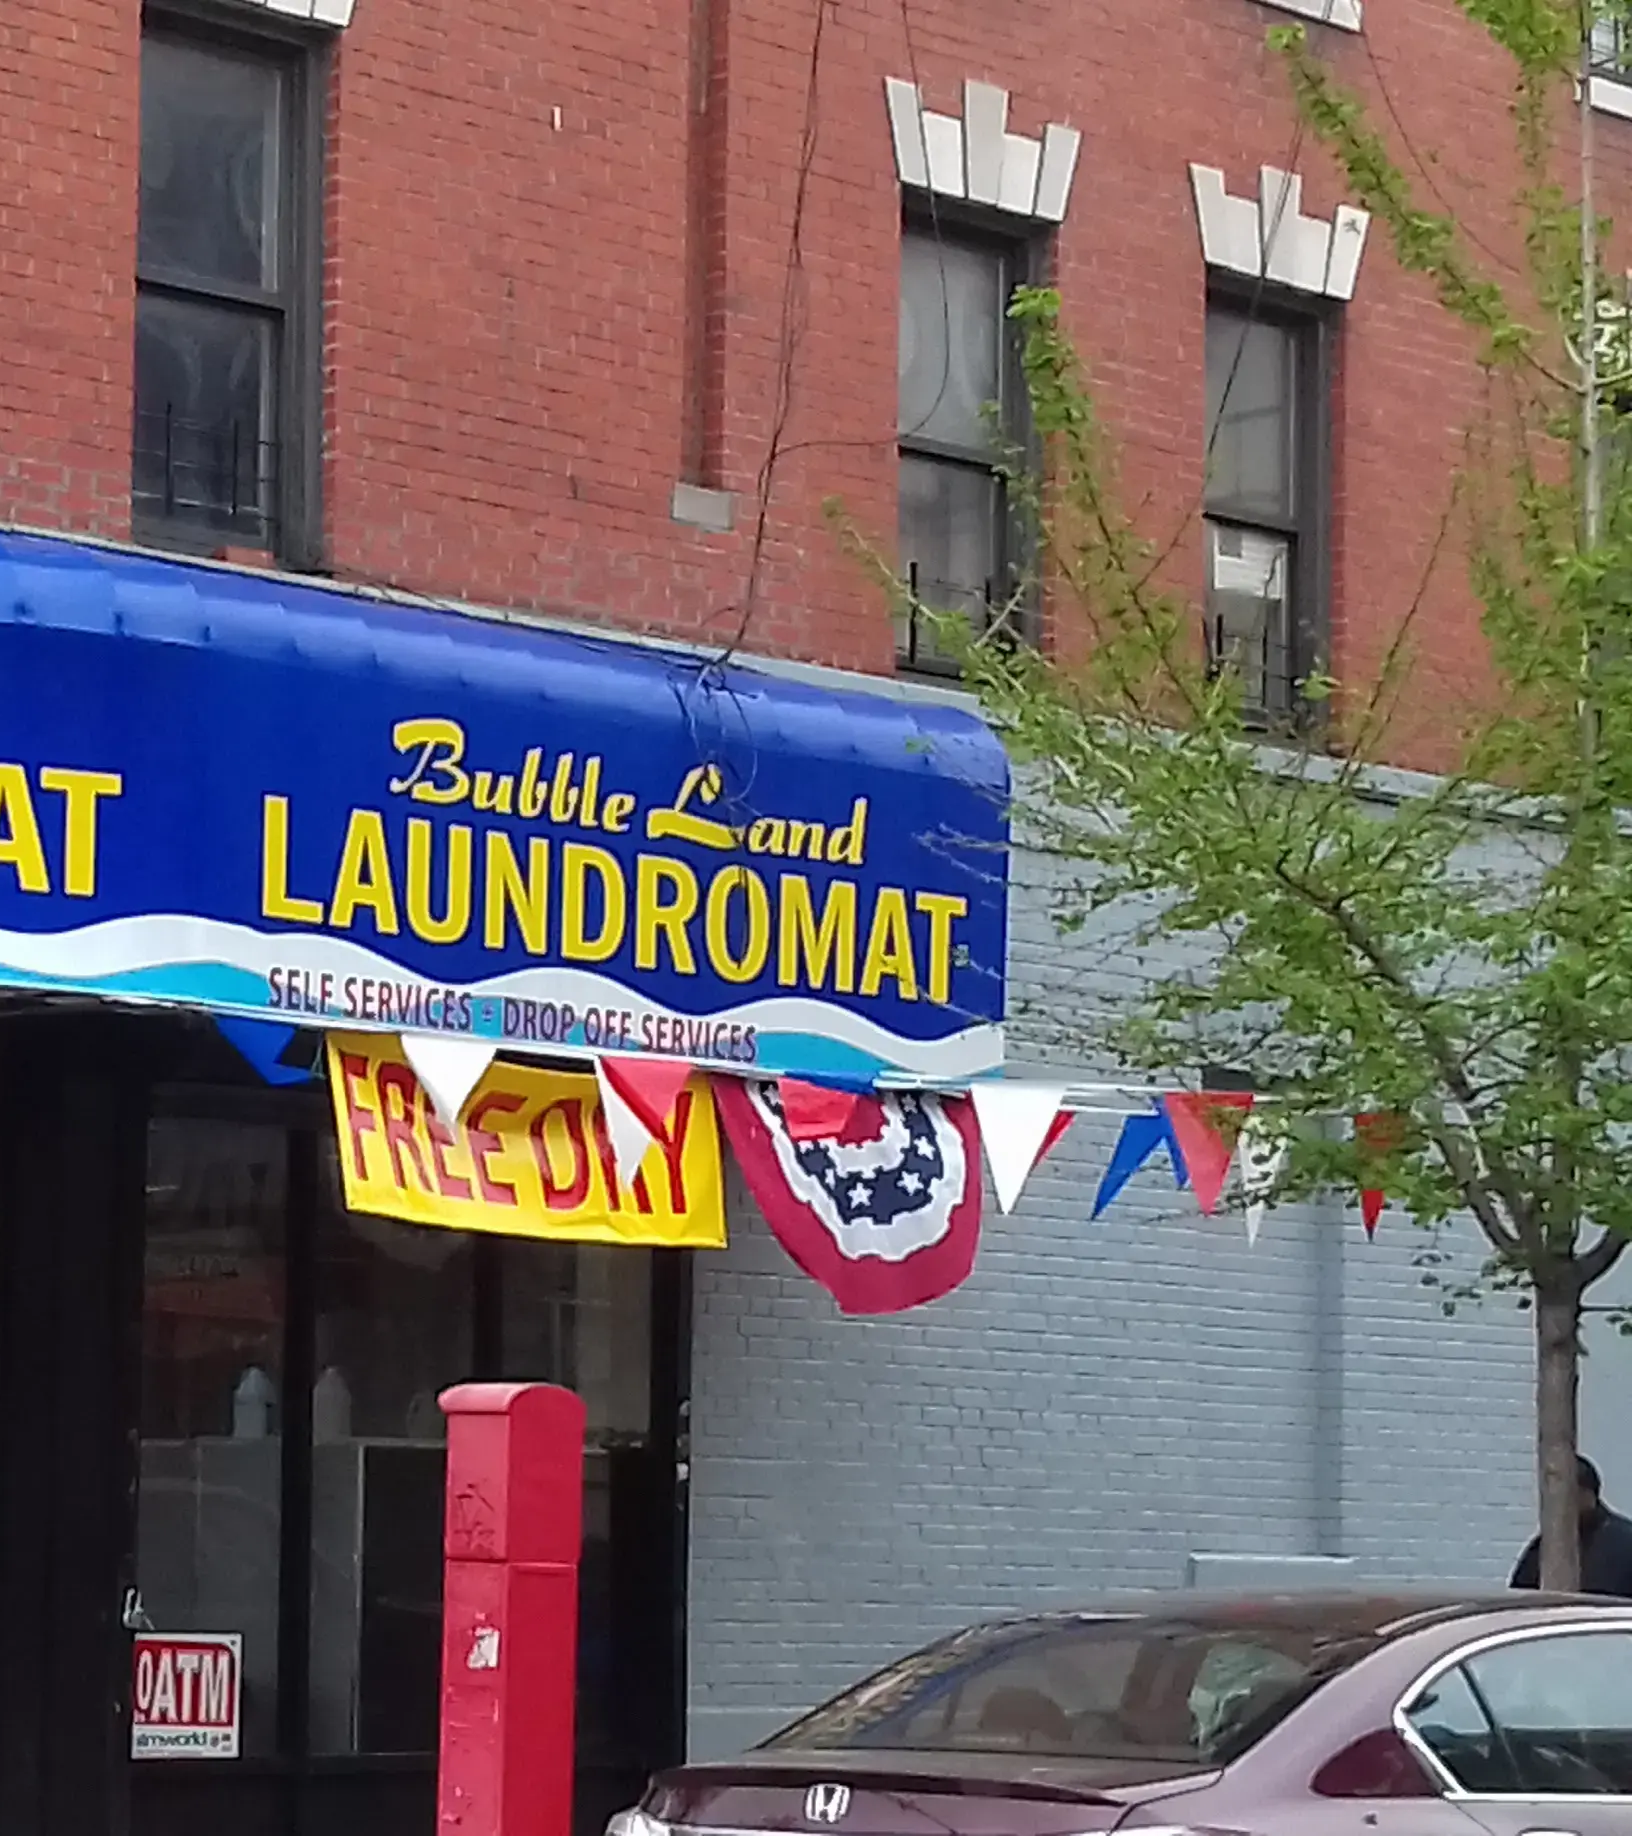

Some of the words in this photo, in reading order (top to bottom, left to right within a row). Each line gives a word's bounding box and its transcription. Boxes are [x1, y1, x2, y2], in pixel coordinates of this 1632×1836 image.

[388, 717, 637, 834] Bubble
[645, 761, 868, 865] Land
[261, 794, 968, 1005] LAUNDROMAT
[269, 966, 334, 1015] SELF
[343, 976, 474, 1031] SERVICES
[503, 997, 576, 1041] DROP
[583, 1007, 633, 1048] OFF
[641, 1012, 757, 1062] SERVICES
[340, 1051, 528, 1208] FREE
